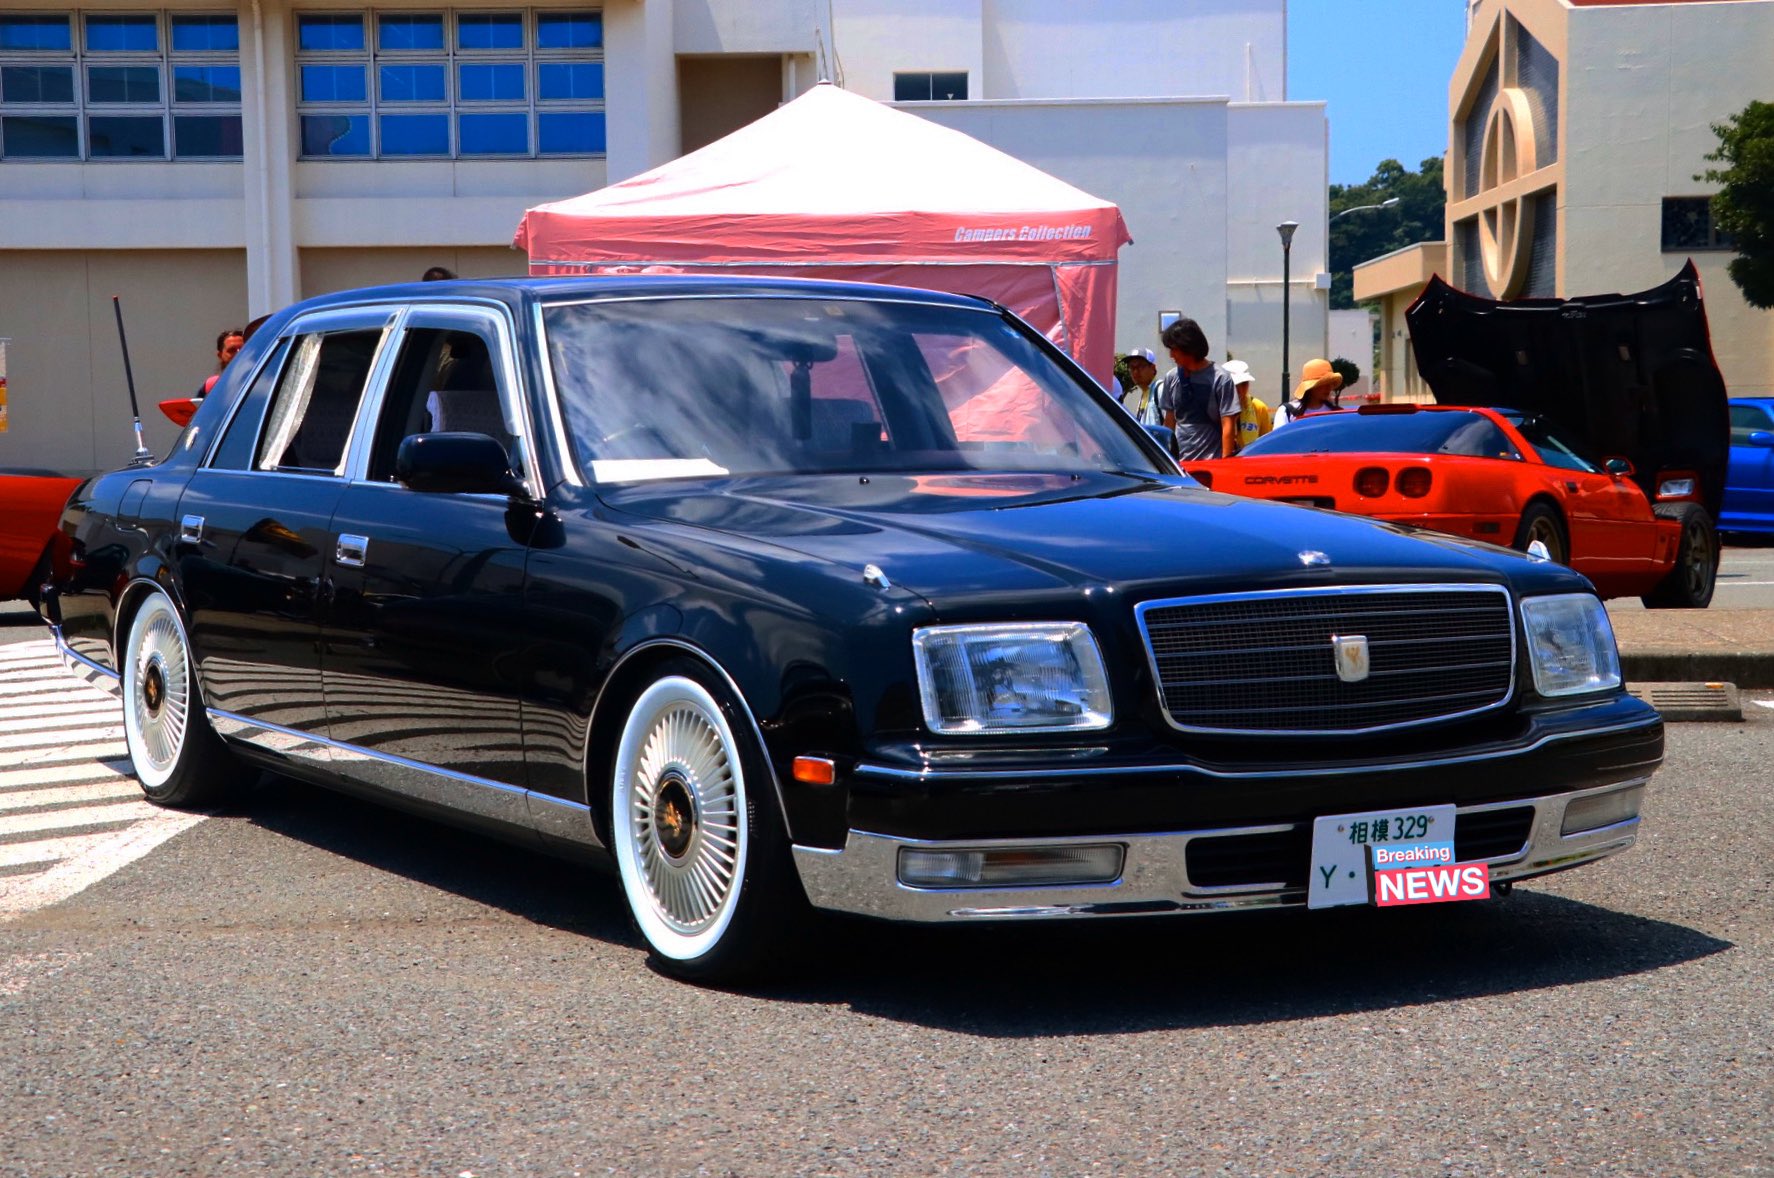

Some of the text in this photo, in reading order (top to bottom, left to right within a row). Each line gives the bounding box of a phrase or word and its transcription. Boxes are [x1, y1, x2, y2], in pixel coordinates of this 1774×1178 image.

[955, 224, 1092, 241] Campers Collection
[1244, 475, 1318, 485] CORVETTE
